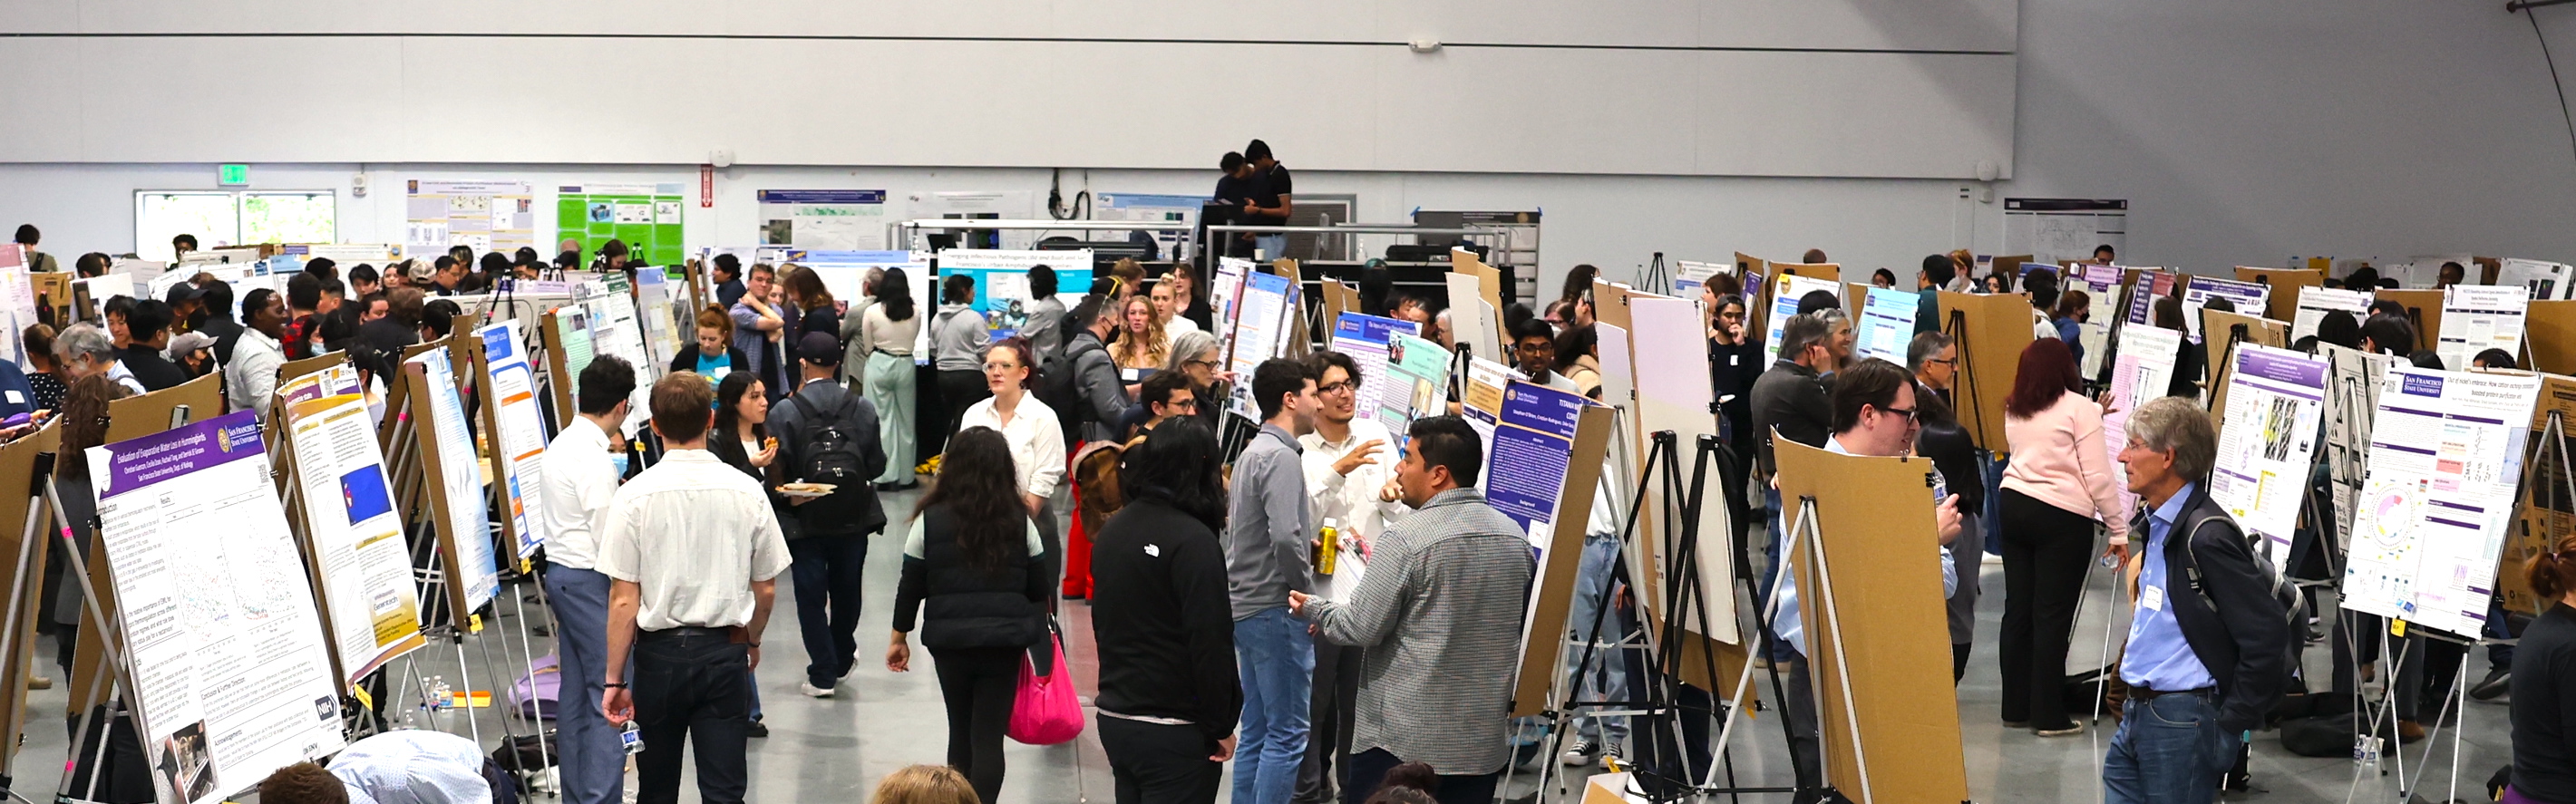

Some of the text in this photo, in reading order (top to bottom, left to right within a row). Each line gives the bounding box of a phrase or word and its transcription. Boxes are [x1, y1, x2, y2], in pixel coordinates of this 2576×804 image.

[2405, 374, 2442, 387] SAN FRANCISCO
[2404, 384, 2440, 394] STATE UNIVERSITY
[228, 424, 256, 436] SAN FRANCISCO
[230, 434, 258, 447] STATE UNIVERSITY
[117, 451, 136, 464] Evaluation
[136, 448, 141, 459] of
[140, 444, 160, 459] Evaporative
[160, 443, 170, 452] Water
[180, 432, 207, 446] Hummingbirds
[373, 596, 398, 611] Genentech
[316, 700, 334, 716] NIH
